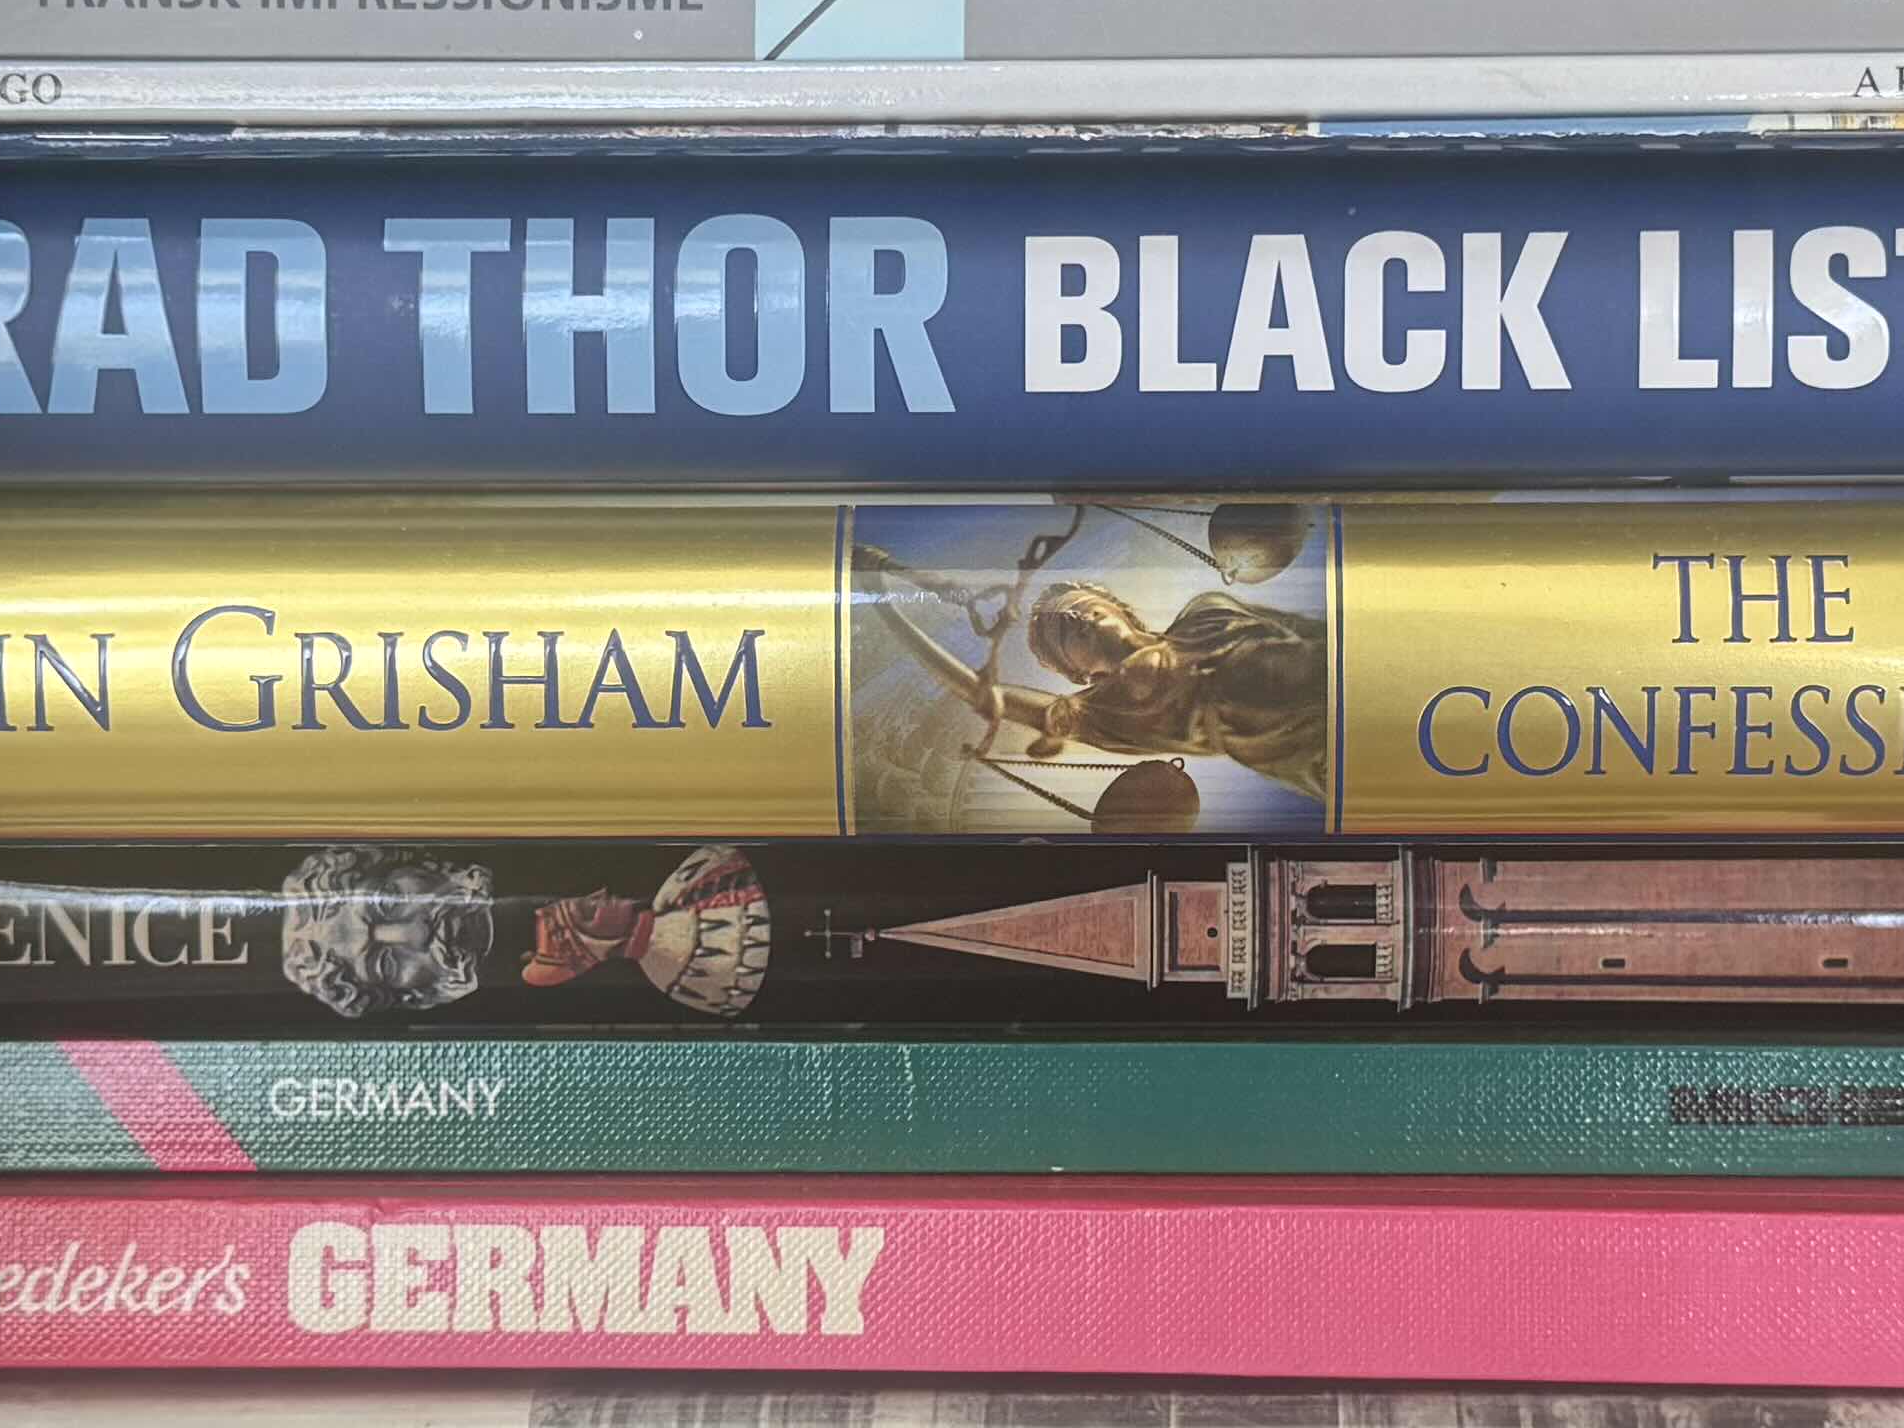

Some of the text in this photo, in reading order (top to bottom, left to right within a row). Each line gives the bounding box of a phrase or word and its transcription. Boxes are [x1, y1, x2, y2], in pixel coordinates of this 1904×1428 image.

[1854, 70, 1883, 98] A
[384, 212, 957, 417] THOR
[1023, 228, 1572, 394] BLACK
[1651, 551, 1856, 645] THE
[171, 604, 771, 735] GRISHAM
[267, 1077, 504, 1119] GERMANY
[285, 1219, 886, 1337] GERMANY
